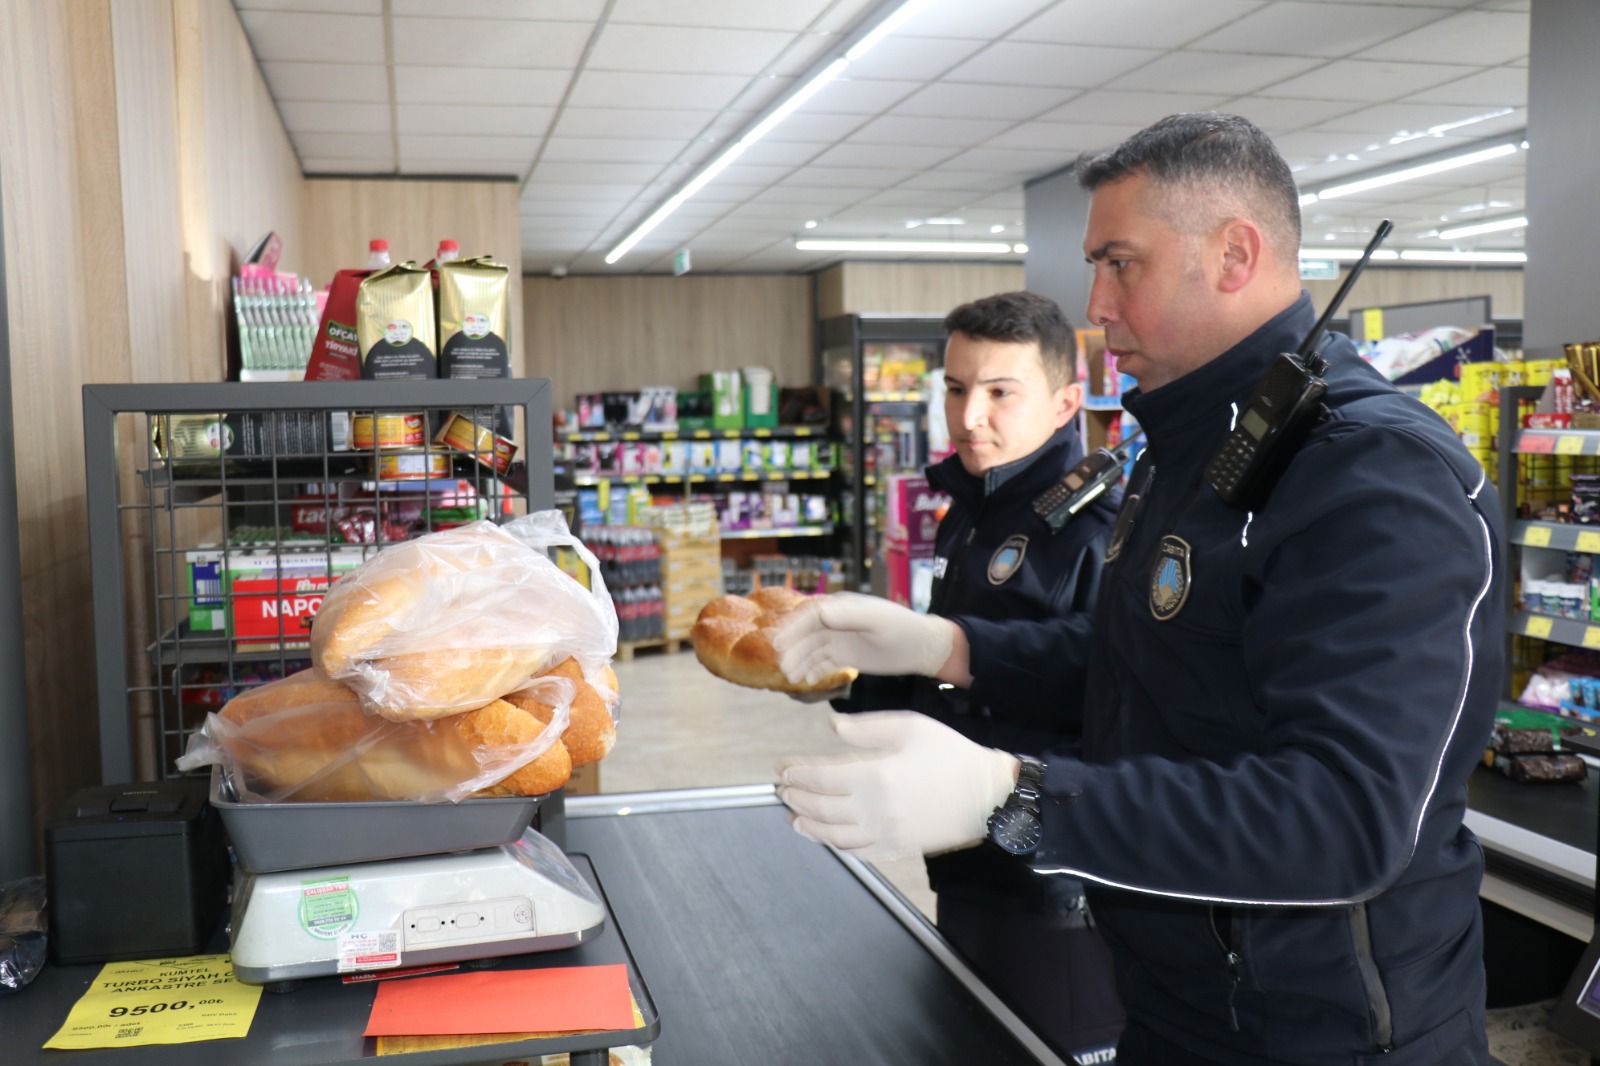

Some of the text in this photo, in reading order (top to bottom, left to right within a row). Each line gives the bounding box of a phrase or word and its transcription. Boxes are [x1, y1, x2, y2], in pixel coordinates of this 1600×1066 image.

[160, 967, 209, 977] KUMTEL
[103, 978, 162, 988] TURBO
[112, 980, 207, 993] ANKASTRE
